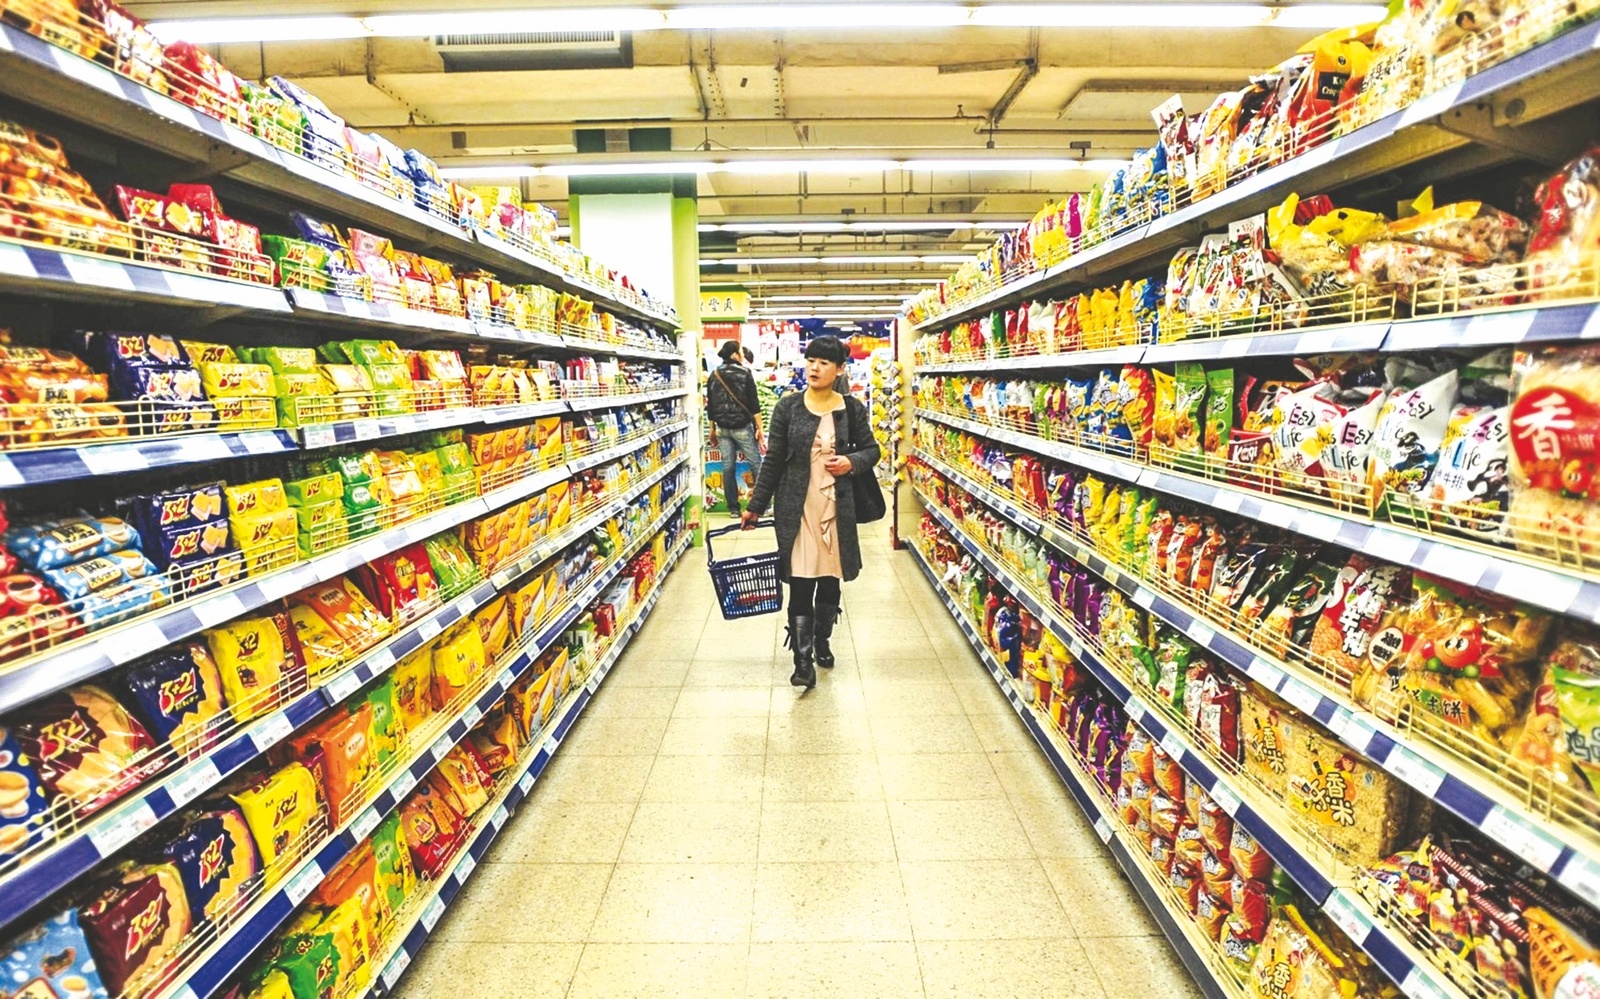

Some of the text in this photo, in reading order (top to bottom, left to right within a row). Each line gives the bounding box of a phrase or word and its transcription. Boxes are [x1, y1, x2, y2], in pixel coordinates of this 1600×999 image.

[119, 336, 145, 359] 3+2
[1288, 403, 1316, 427] Easy
[1512, 391, 1576, 461] 香
[1341, 421, 1375, 447] Easy
[1331, 445, 1361, 470] Life
[1452, 440, 1481, 471] Life
[161, 498, 189, 526] 3+2
[171, 530, 201, 558] 3+2
[252, 522, 274, 544] 3+2
[188, 562, 215, 593] 3+2
[160, 672, 192, 718] 3+2
[40, 718, 85, 762] 3+2
[274, 791, 298, 829] 3+2
[1325, 771, 1355, 827] 香米
[200, 840, 222, 885] 3+2
[129, 900, 158, 956] 3+2
